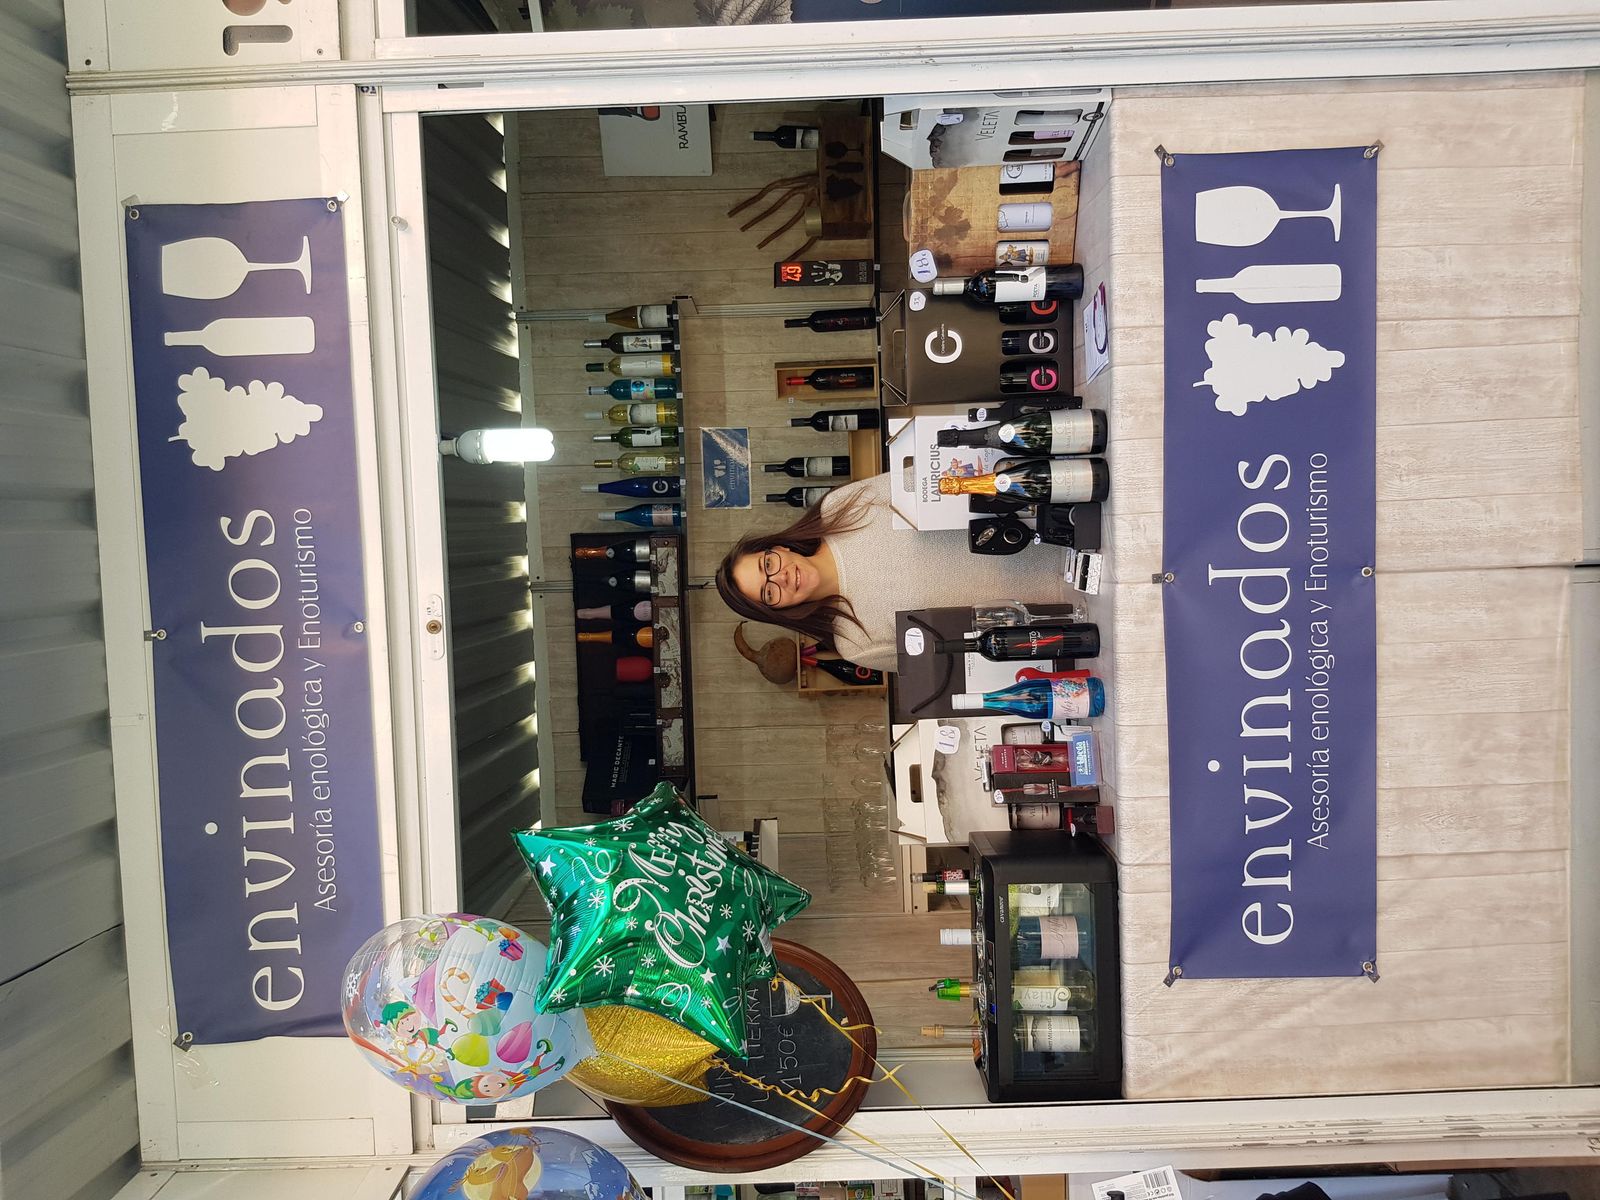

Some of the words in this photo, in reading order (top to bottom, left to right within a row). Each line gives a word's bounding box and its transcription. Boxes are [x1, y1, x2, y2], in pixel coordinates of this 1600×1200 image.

[974, 109, 1001, 142] VELETA
[786, 265, 802, 282] 49
[929, 443, 942, 502] LAURICIUS
[1305, 452, 1329, 591] Enoturismo
[293, 508, 321, 650] Enoturismo
[1310, 599, 1333, 614] y
[303, 657, 326, 672] y
[1028, 630, 1039, 656] TALENTO
[1305, 619, 1336, 741] enológica
[301, 677, 332, 800] enológica
[1208, 453, 1294, 946] envinados
[201, 508, 305, 1011] envinados
[610, 766, 619, 788] MAGIC
[614, 735, 624, 765] DECANTE
[1305, 747, 1330, 849] Asesoría
[310, 807, 337, 911] Asesoría
[612, 821, 704, 913] Merry
[644, 826, 728, 968] Christma
[745, 988, 765, 1066] TIERRA
[776, 1024, 802, 1090] 1'50€
